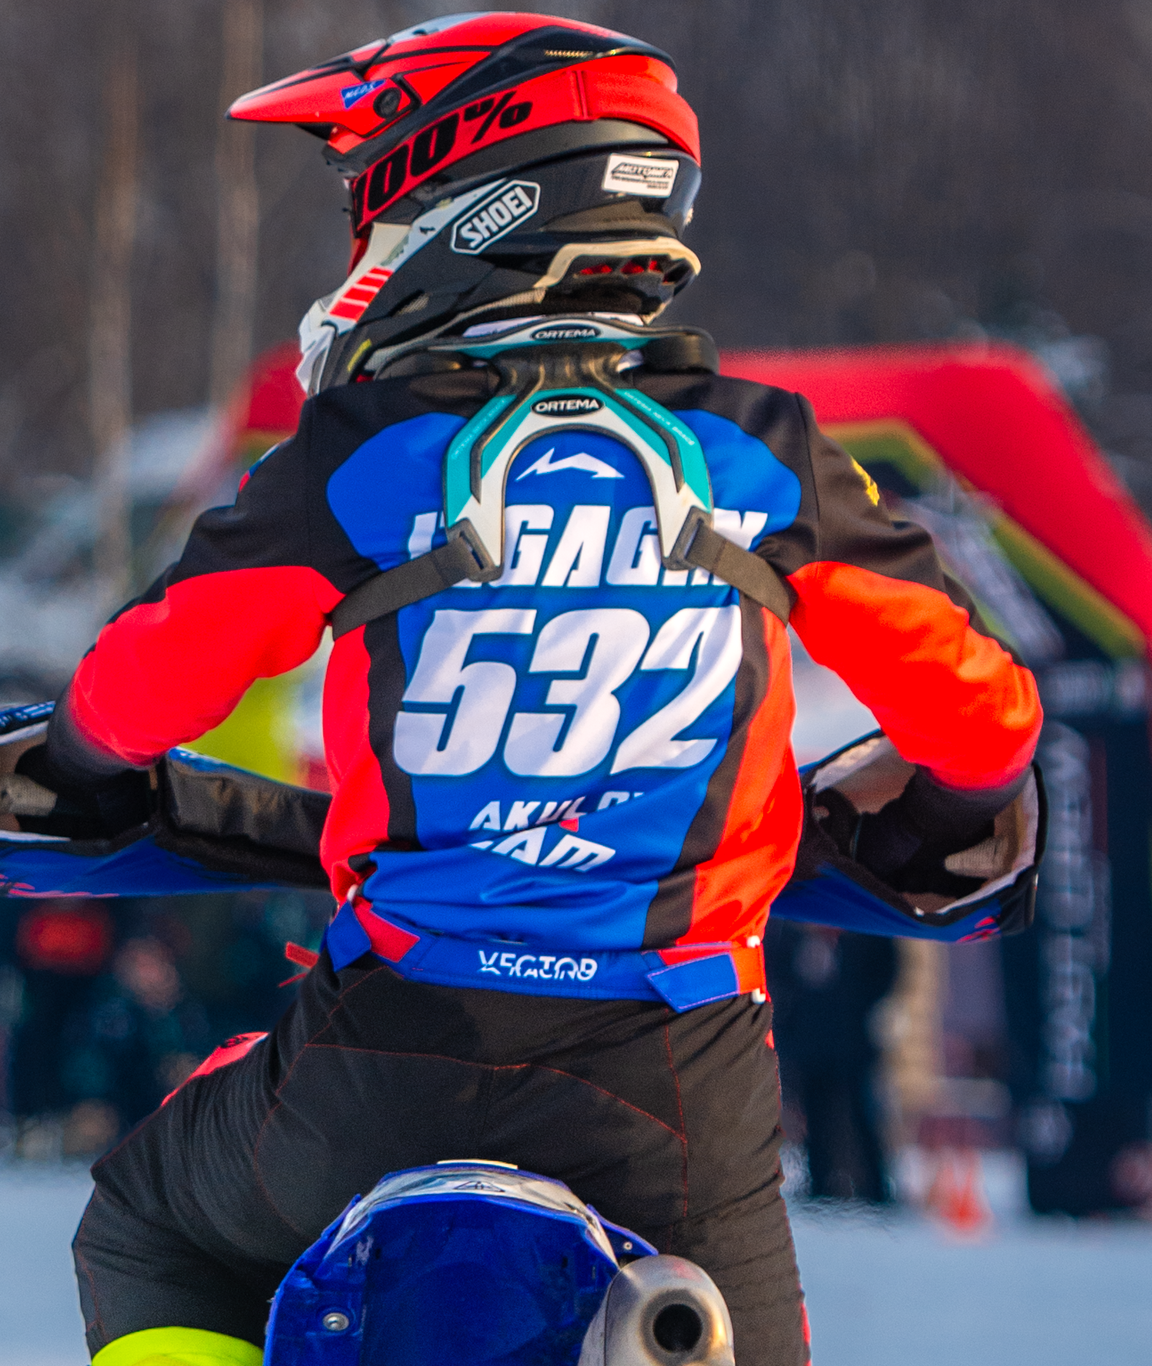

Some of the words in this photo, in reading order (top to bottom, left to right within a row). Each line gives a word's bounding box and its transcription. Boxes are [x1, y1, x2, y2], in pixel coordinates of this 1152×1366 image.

[460, 185, 533, 249] SHOEI
[534, 328, 597, 340] ORTEMA
[535, 399, 600, 413] ORTEMA
[393, 604, 743, 777] 532
[468, 791, 645, 832] AKULO
